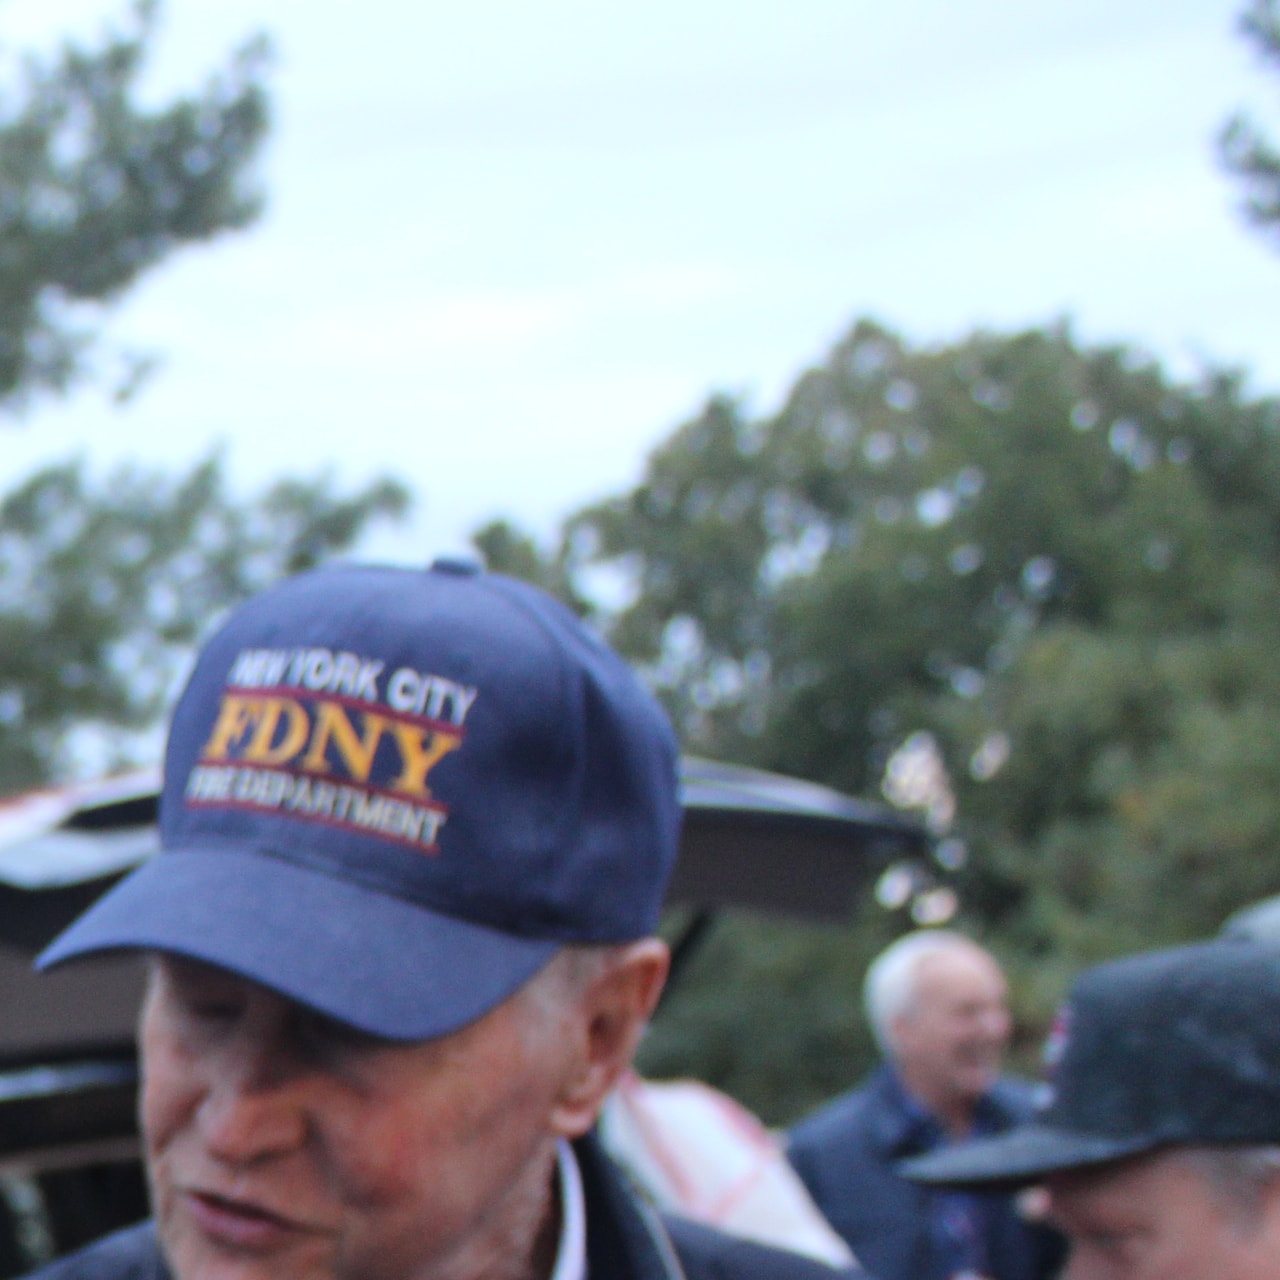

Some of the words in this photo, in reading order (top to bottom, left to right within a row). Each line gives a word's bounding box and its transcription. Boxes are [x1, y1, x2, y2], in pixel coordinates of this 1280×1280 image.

[227, 649, 288, 687] NEW
[287, 646, 385, 703] YORK
[388, 668, 477, 726] CITY
[203, 692, 462, 798] FDNY
[235, 767, 448, 845] DEPARTMENT
